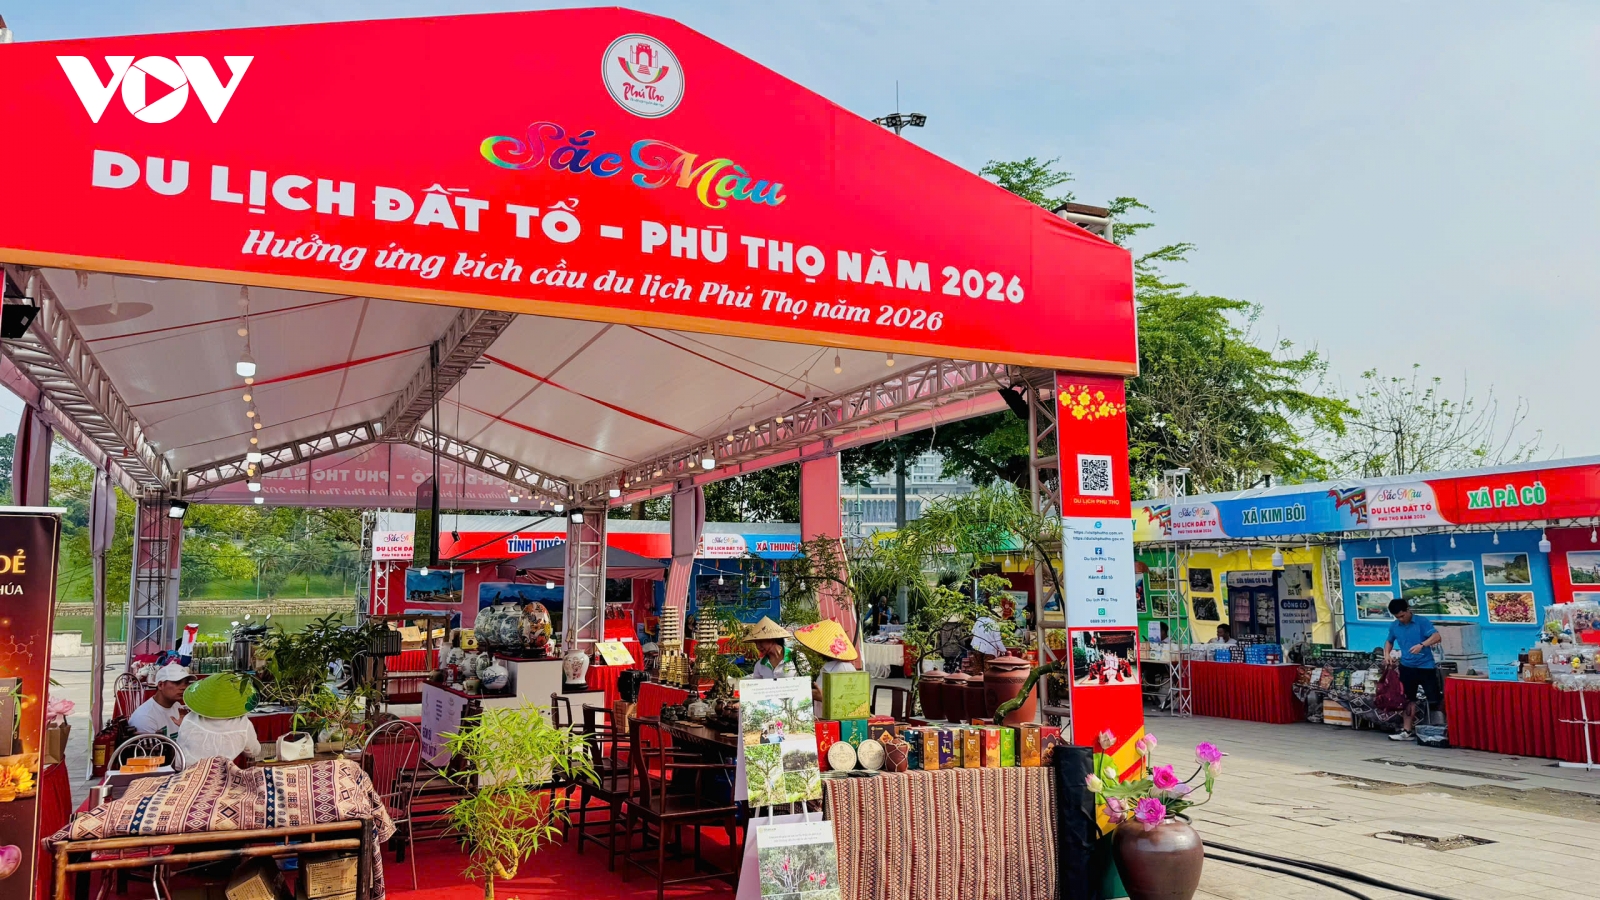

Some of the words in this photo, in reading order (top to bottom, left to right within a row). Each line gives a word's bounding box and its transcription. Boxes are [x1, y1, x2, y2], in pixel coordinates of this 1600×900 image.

[622, 81, 646, 101] Phú
[645, 85, 665, 103] Thọ
[479, 121, 623, 178] Sắc
[630, 139, 786, 209] Màu
[91, 149, 190, 196] DU
[210, 164, 356, 217] LỊCH
[372, 183, 490, 232] ĐẤT
[506, 198, 581, 244] TỔ
[740, 235, 826, 284] THỌ
[837, 248, 931, 292] NĂM
[941, 265, 1025, 304] 2026
[241, 229, 368, 271] Hưởng
[374, 242, 446, 279] ứng
[452, 251, 523, 283] kích
[529, 258, 588, 290] cầu
[593, 270, 635, 294] du
[639, 274, 693, 303] lịch
[698, 281, 754, 308] Phú
[760, 289, 808, 320] Thọ
[812, 299, 871, 323] năm
[875, 305, 944, 331] 2026
[1378, 489, 1396, 502] Sắc
[1397, 488, 1422, 502] Màu
[1469, 488, 1492, 509] XÃ
[1494, 486, 1518, 506] PÀ
[1521, 482, 1546, 504] CÒ
[1243, 508, 1258, 524] XÃ
[1261, 508, 1282, 523] KIM
[1286, 503, 1306, 521] BÔI
[1383, 506, 1400, 515] LỊCH
[507, 535, 532, 552] TỈNH
